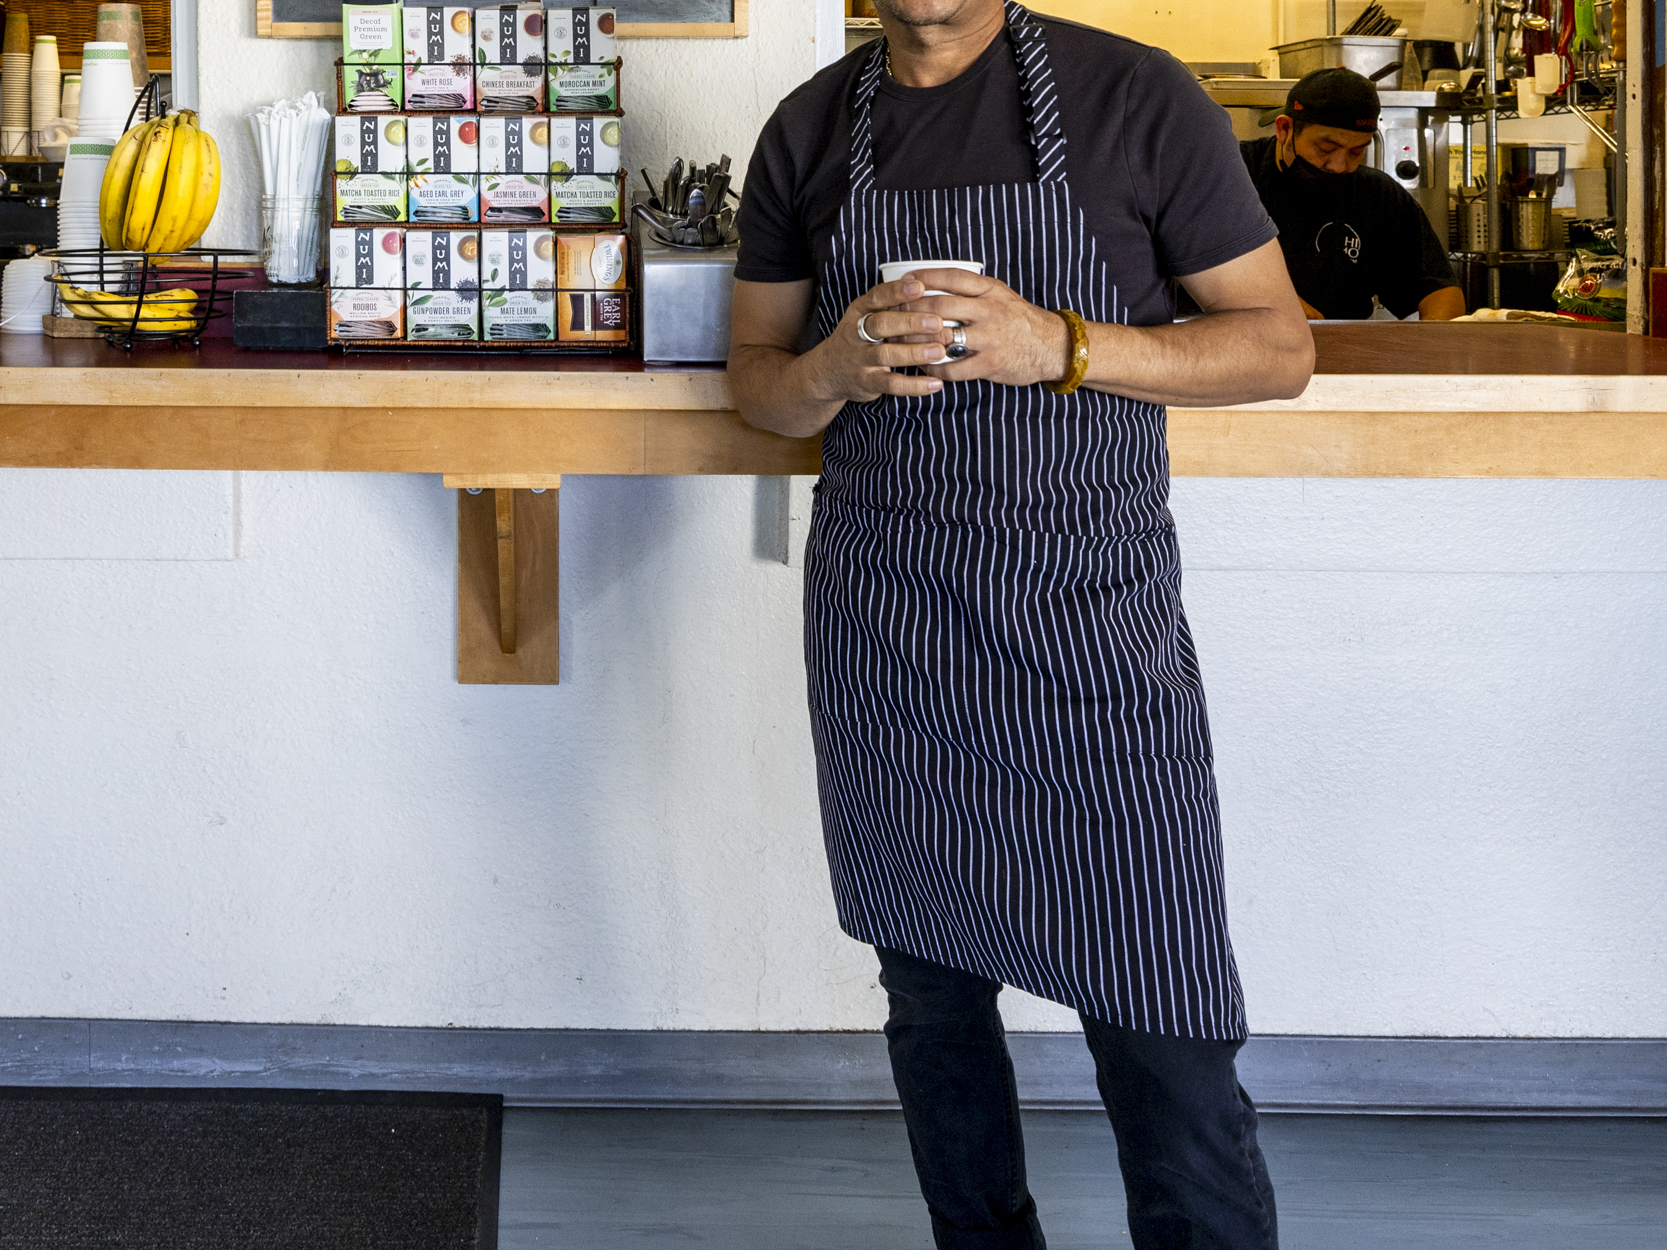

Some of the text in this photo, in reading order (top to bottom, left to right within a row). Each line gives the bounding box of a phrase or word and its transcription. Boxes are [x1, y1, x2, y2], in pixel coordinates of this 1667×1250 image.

[359, 17, 382, 26] Decaf
[353, 25, 388, 33] Premium
[421, 78, 453, 86] WHITE ROSE
[481, 80, 535, 89] CHINESE BREAKFAST
[559, 80, 606, 88] MOROCCAN MINT
[340, 189, 400, 197] MATCHA TOASTED RICE
[418, 190, 465, 198] AGED EARL GREY
[492, 191, 537, 199] JASMINE GREEN
[352, 303, 377, 311] ROOIBOS
[412, 306, 472, 315] GUNPOWDER GREEN
[500, 307, 537, 315] MATE LEMON
[603, 297, 612, 326] GREY
[611, 298, 621, 326] EARL
